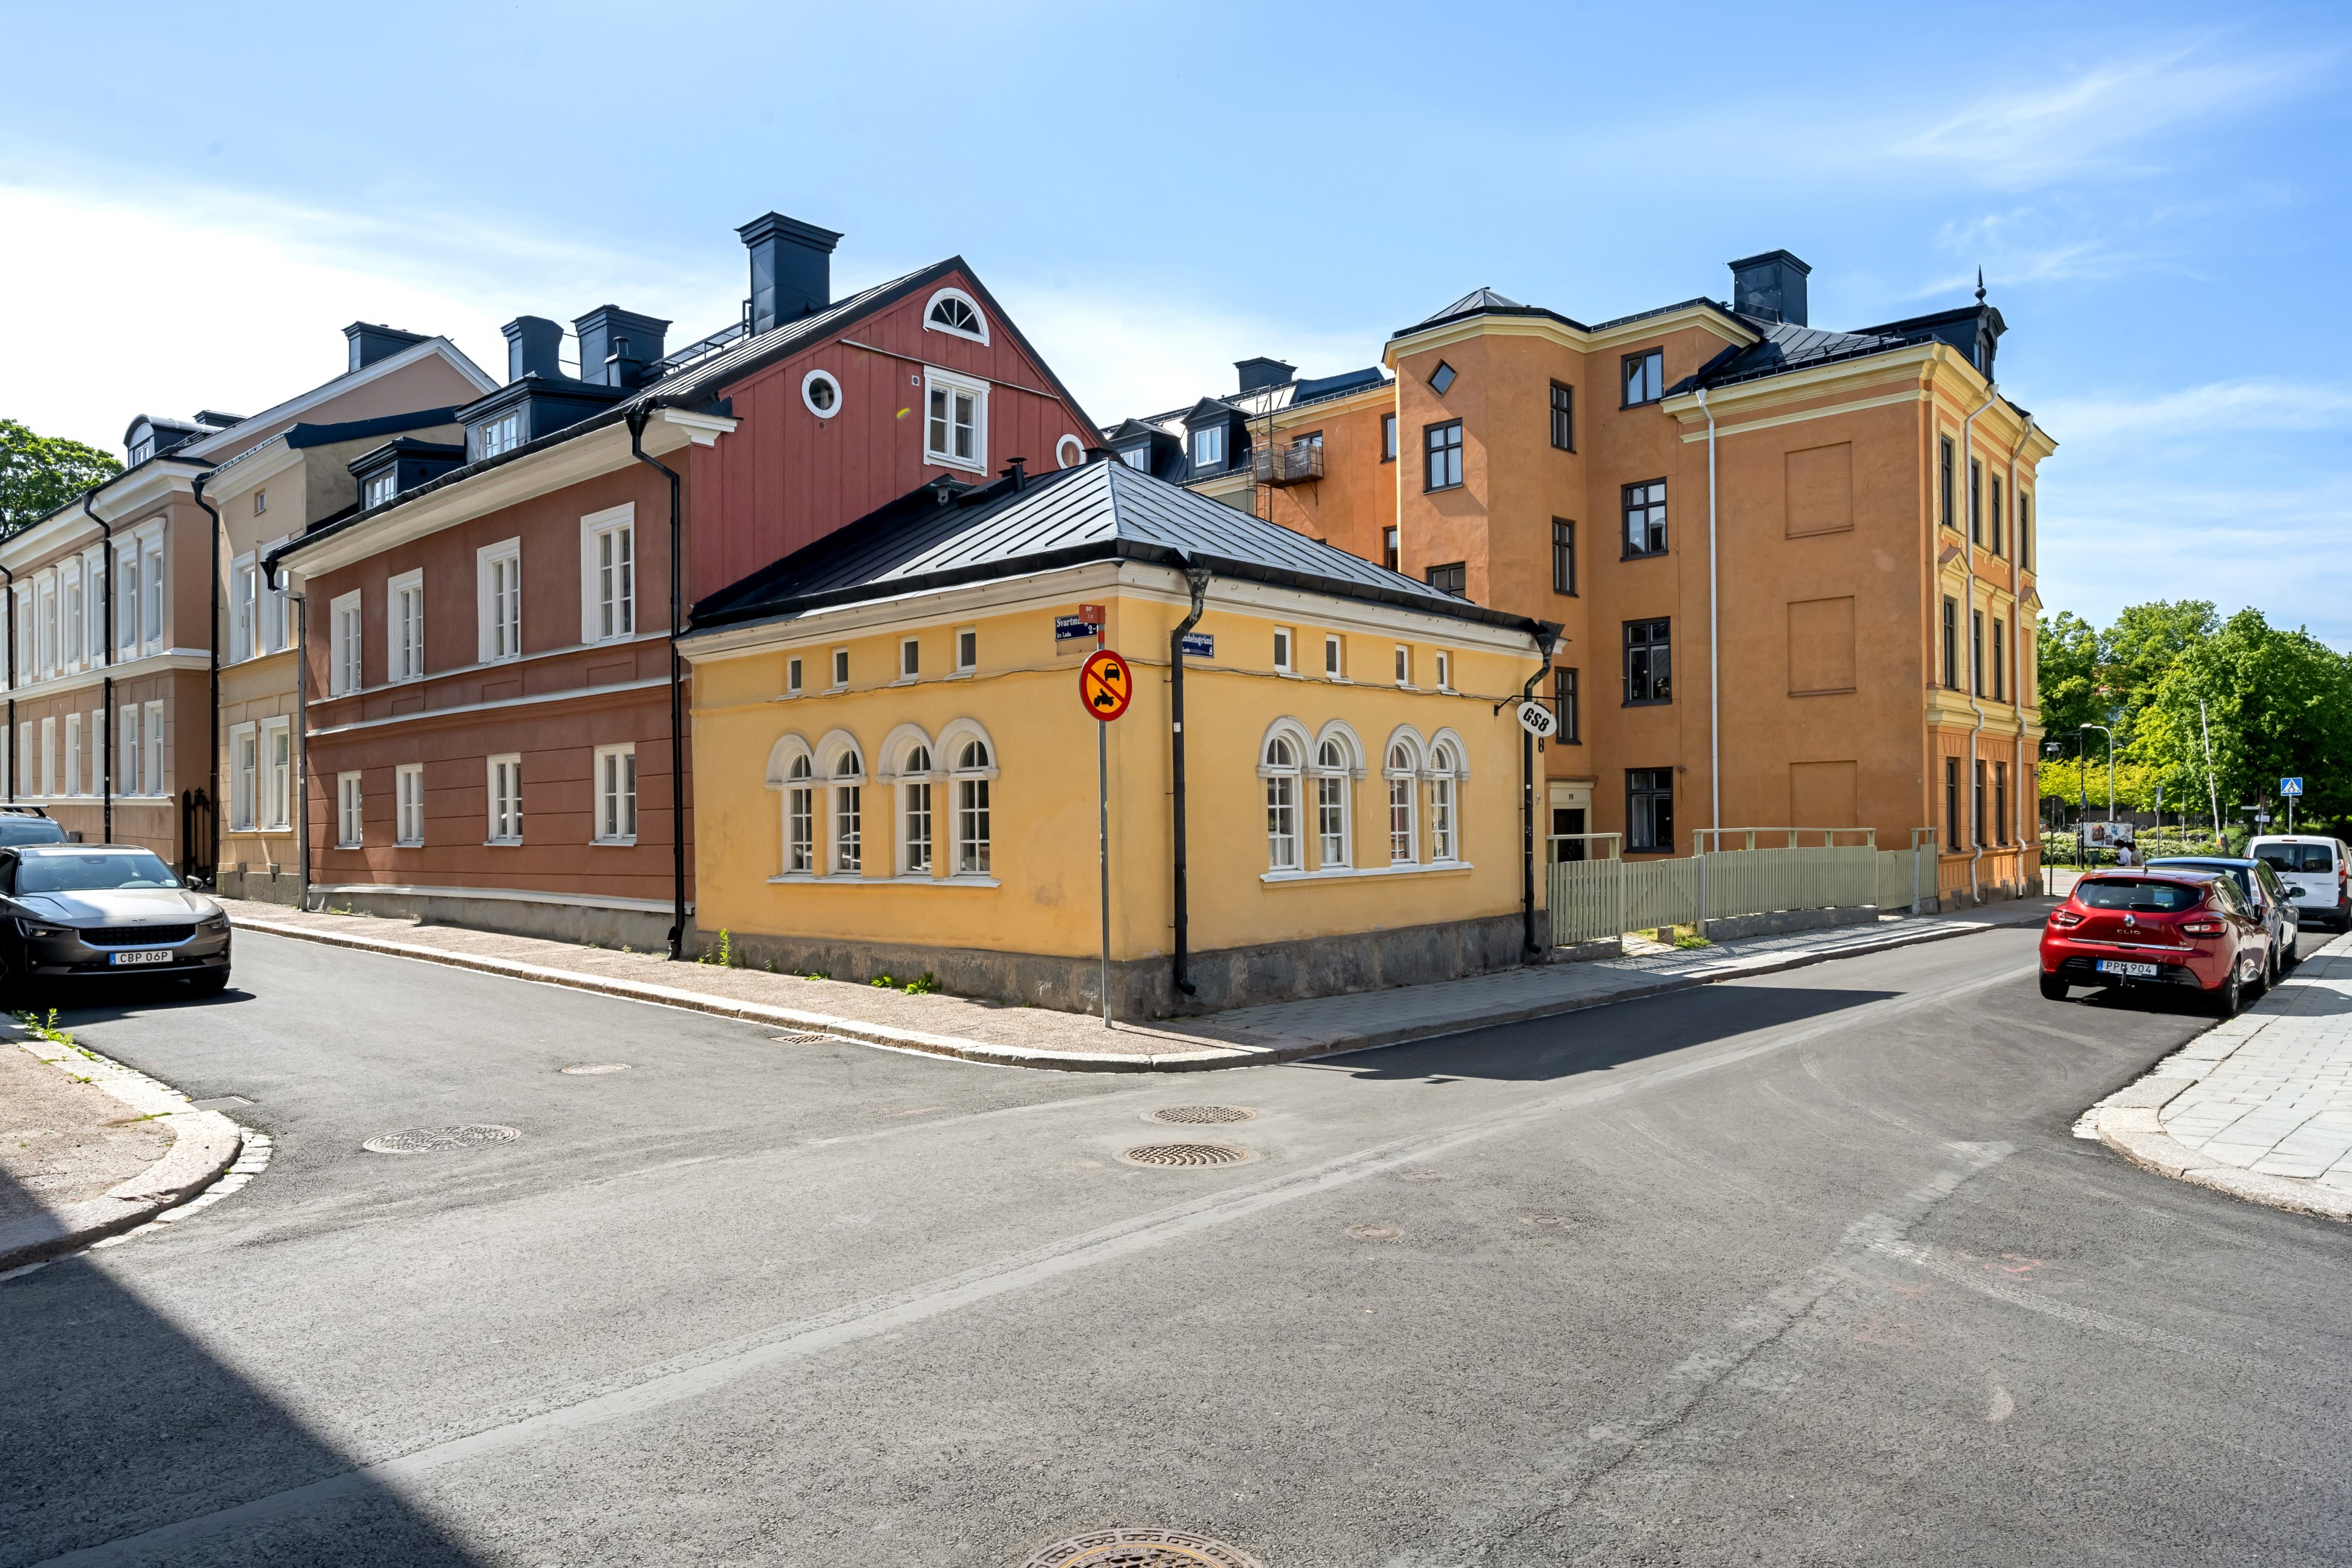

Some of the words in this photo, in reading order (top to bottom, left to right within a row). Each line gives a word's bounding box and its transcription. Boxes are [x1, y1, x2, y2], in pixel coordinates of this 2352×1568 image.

[1209, 647, 1213, 656] 8
[1523, 707, 1550, 732] GS8
[1538, 738, 1545, 753] 8
[120, 953, 142, 963] CBP
[146, 952, 168, 962] 06P
[2131, 964, 2152, 973] 904
